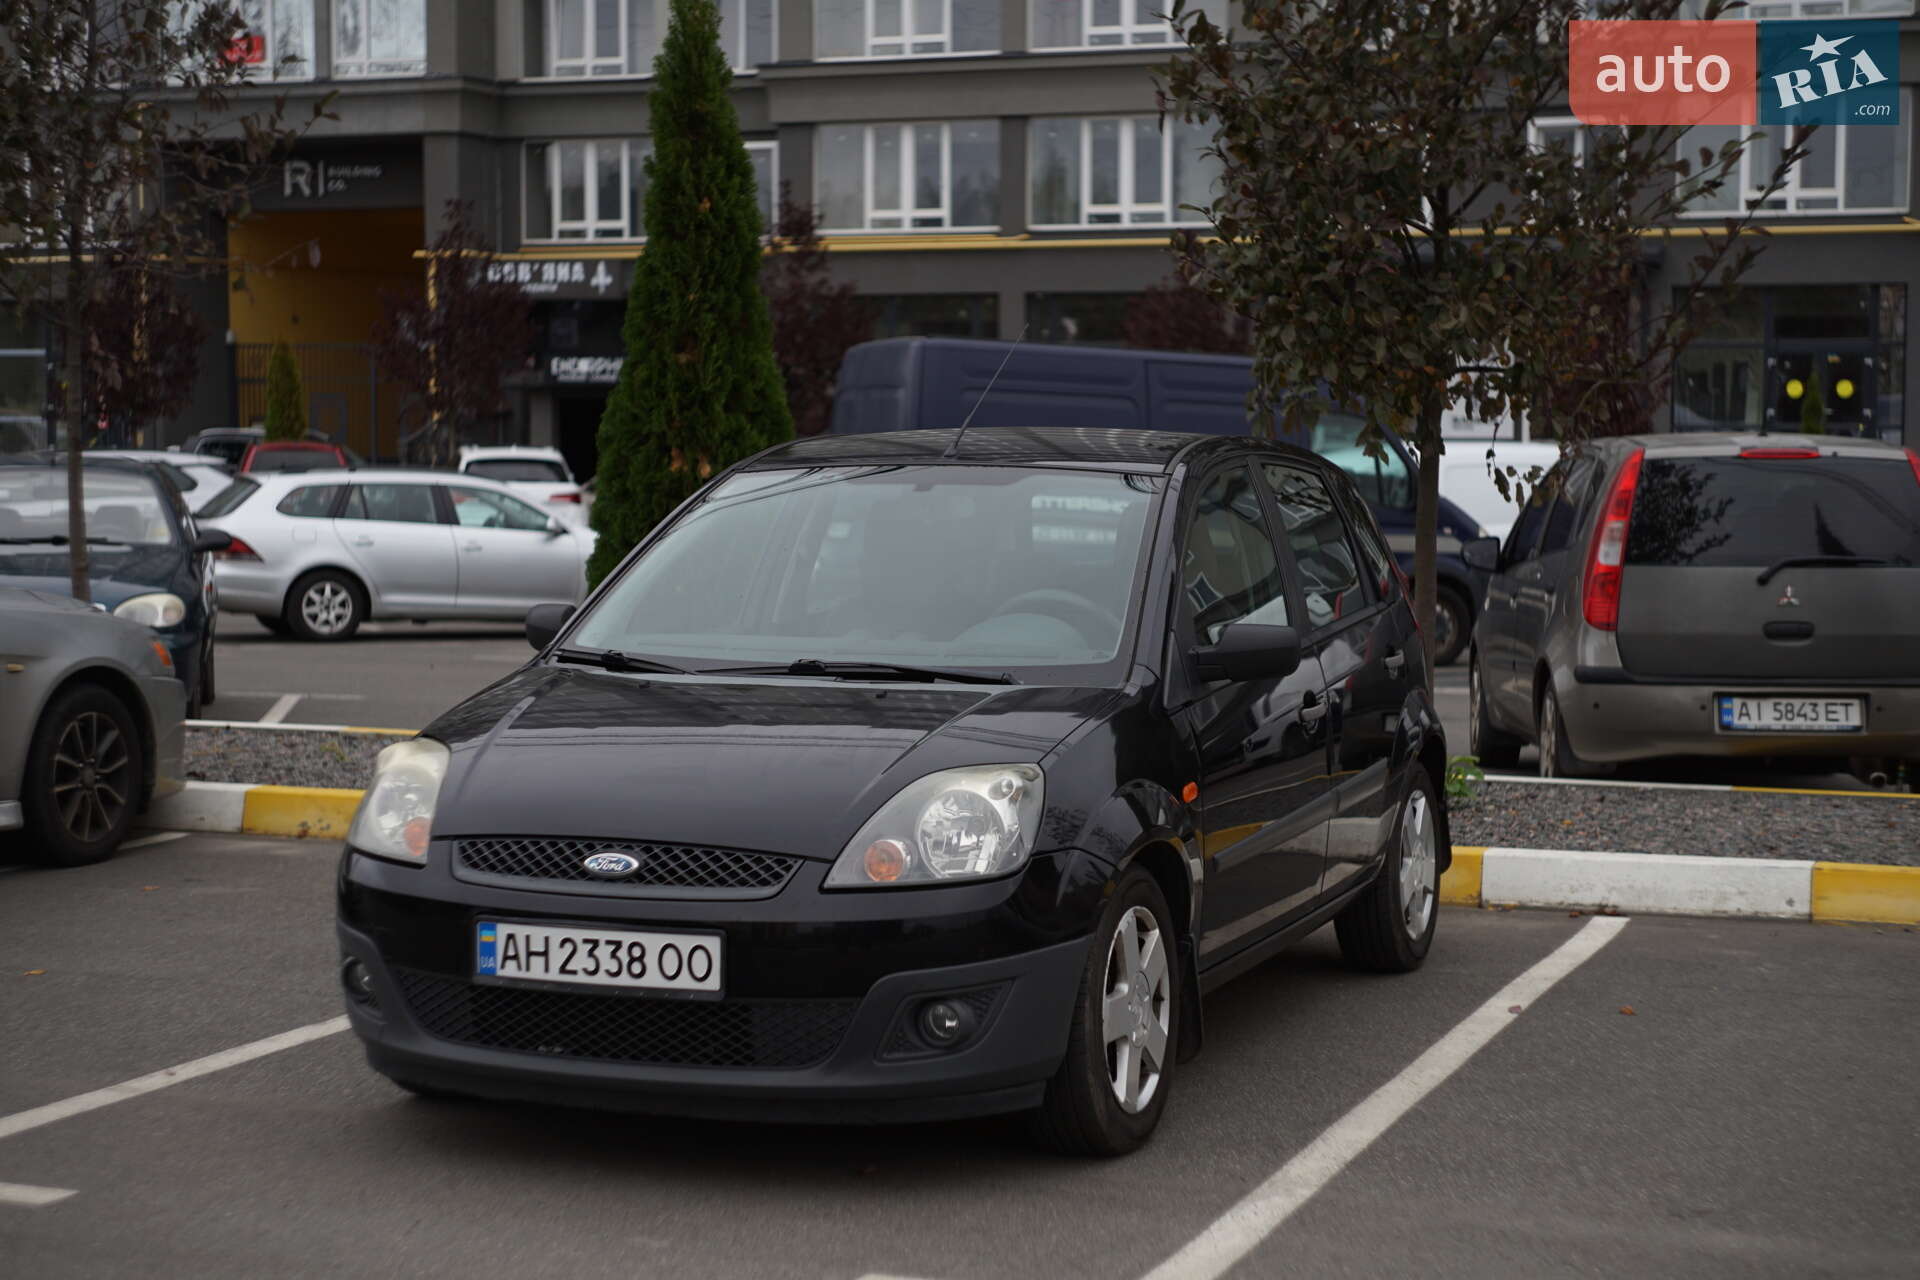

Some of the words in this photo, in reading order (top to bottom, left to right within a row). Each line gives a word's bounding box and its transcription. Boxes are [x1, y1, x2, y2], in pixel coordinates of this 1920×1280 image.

[1737, 702, 1762, 721] AI
[1772, 702, 1820, 721] 5843
[1824, 702, 1854, 722] ET
[590, 856, 627, 871] Ford
[480, 956, 496, 968] UA
[500, 933, 550, 974] AH
[558, 936, 648, 980] 2338
[657, 942, 713, 983] OO
